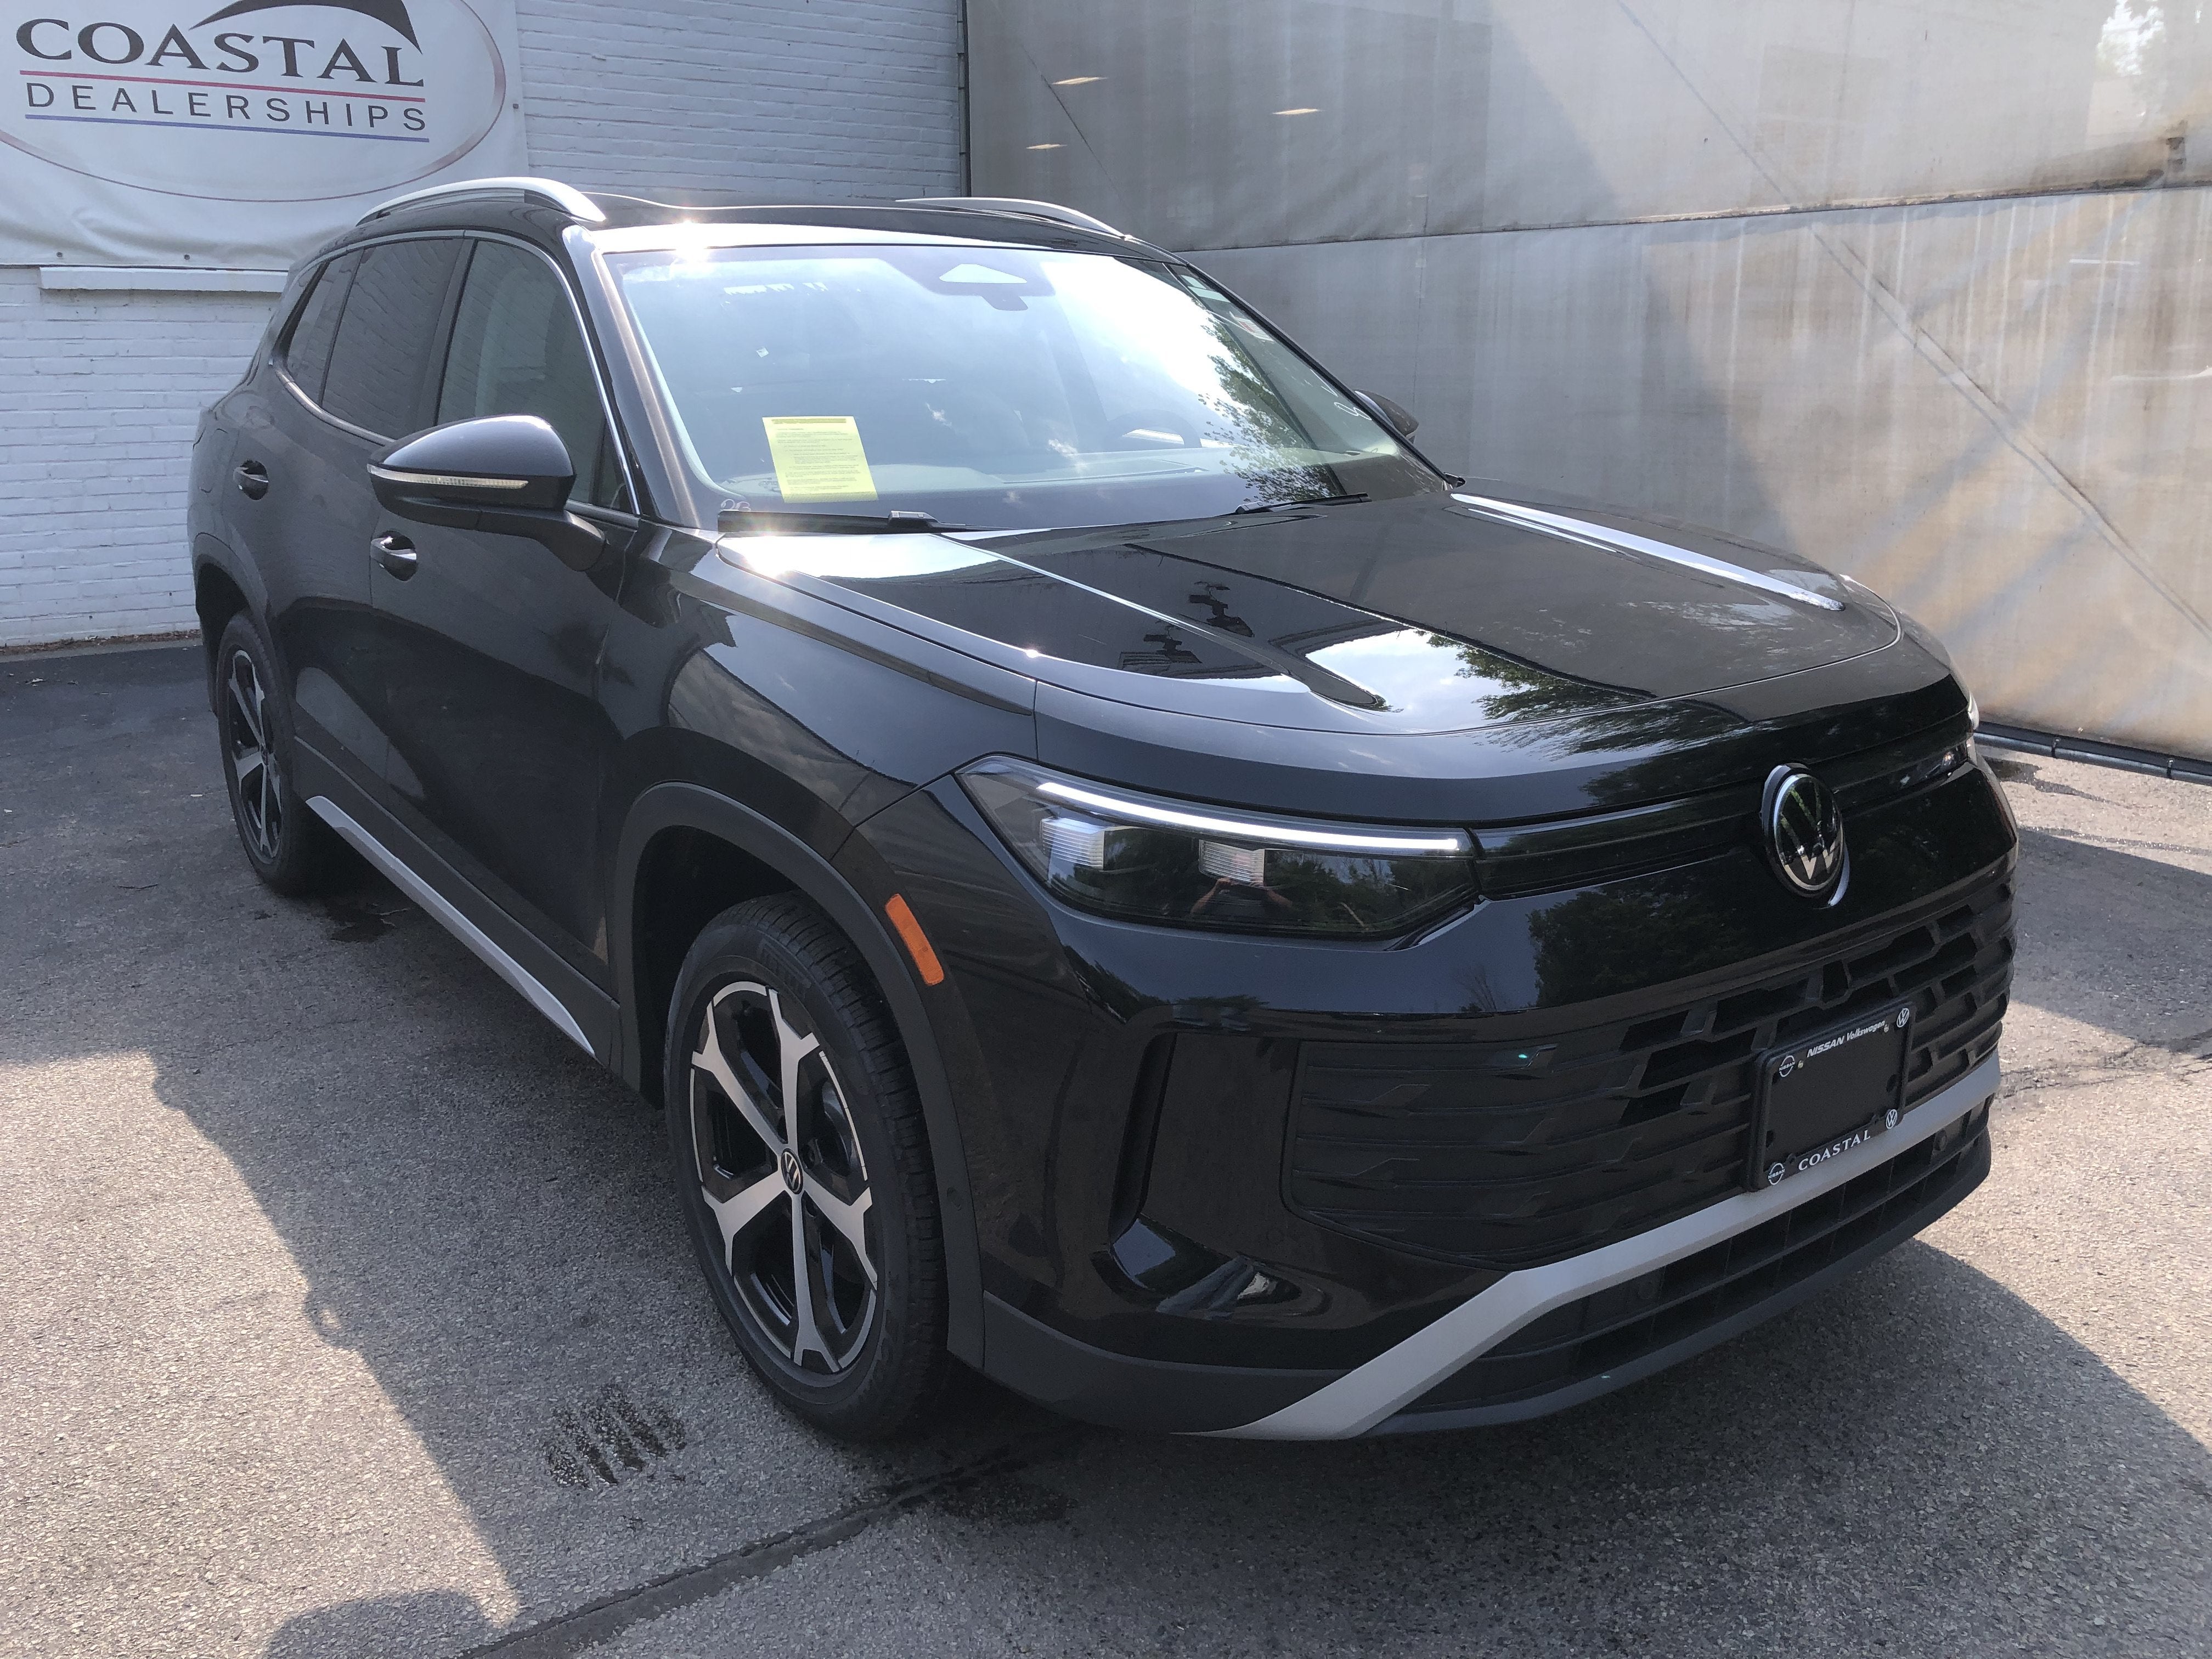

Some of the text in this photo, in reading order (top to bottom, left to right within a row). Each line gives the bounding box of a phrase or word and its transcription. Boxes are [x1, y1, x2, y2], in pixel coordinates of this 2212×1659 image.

[16, 18, 425, 87] COASTAL
[26, 82, 427, 132] DEALERSHIPS
[1807, 1020, 1886, 1058] NISSAN Volkswagen
[1798, 1129, 1871, 1171] COASTAL
